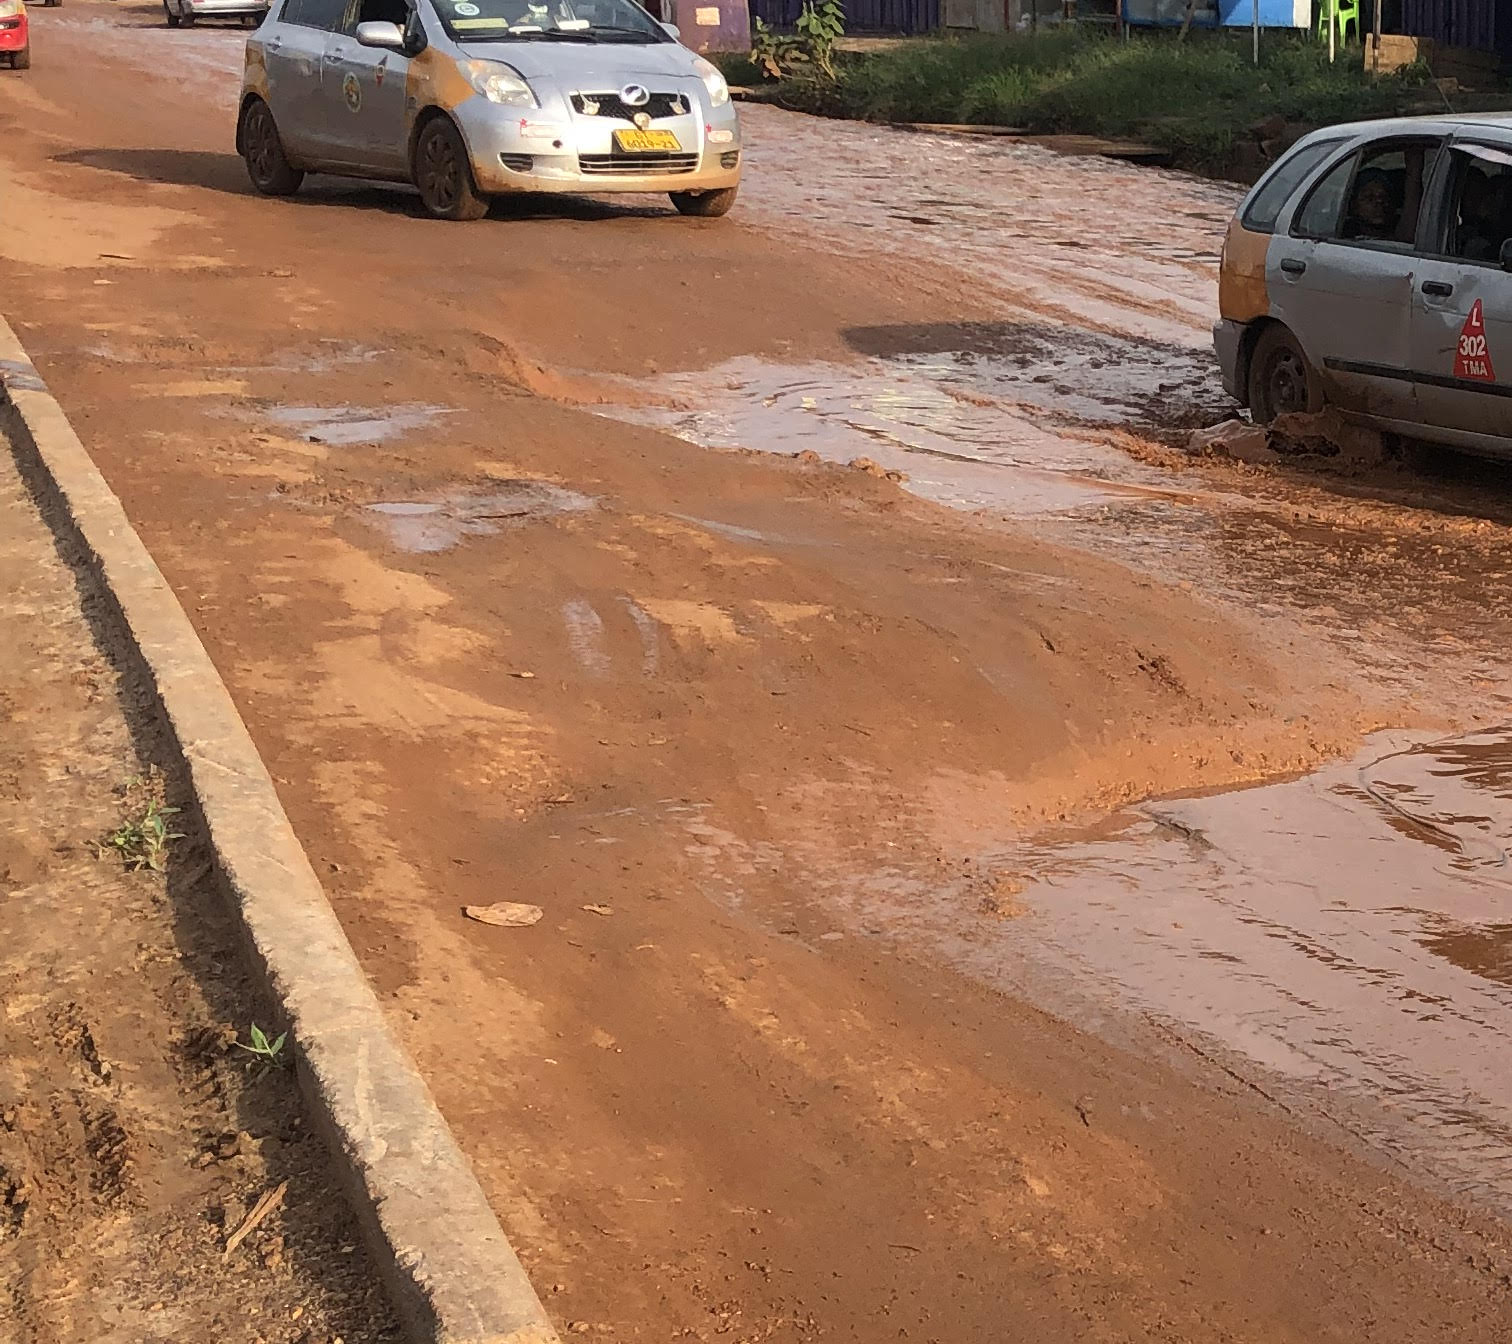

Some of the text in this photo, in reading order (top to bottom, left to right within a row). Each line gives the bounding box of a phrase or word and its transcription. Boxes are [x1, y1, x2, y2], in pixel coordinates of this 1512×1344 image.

[1472, 307, 1481, 327] L
[1460, 335, 1486, 357] 302
[1462, 360, 1488, 376] TMA
